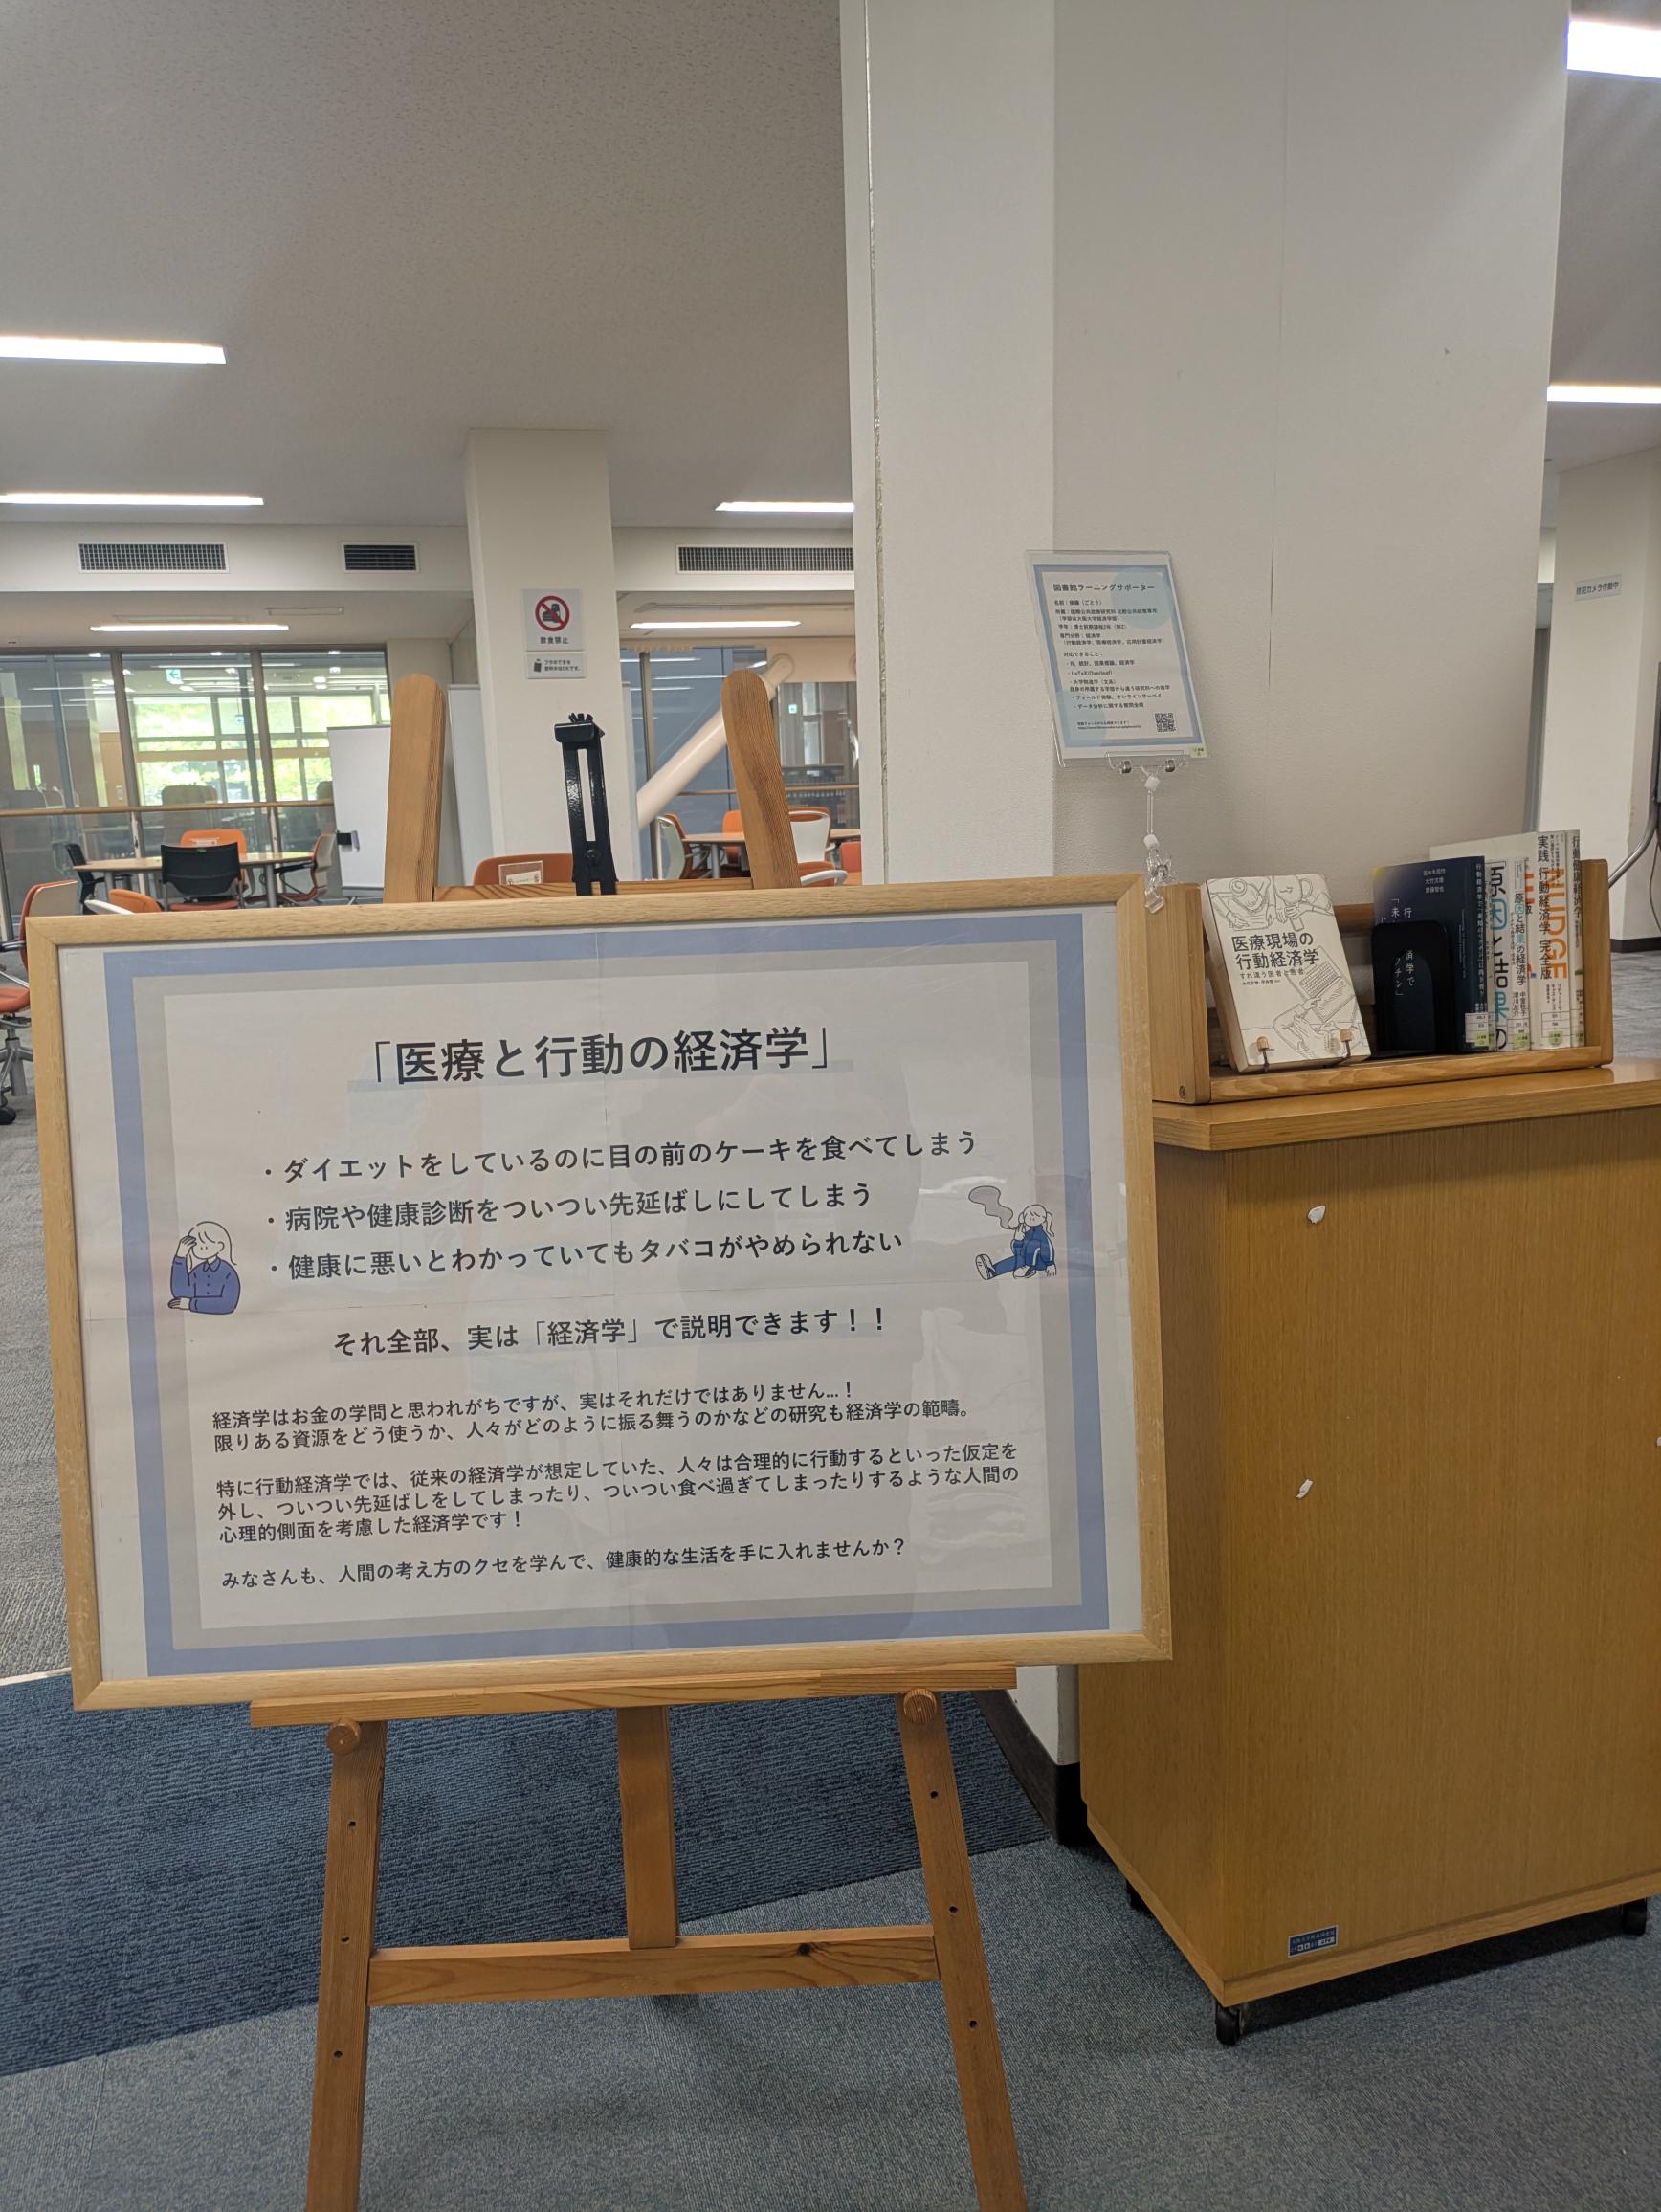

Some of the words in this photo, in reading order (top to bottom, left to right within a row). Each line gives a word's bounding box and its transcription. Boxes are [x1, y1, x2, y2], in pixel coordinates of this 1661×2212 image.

[1052, 583, 1156, 592] 図書館ラーニングサポーター
[540, 636, 569, 645] 飲食禁止
[1538, 835, 1550, 863] 実践
[1539, 867, 1551, 936] 行動経済学
[1231, 932, 1314, 953] 医療現場の
[1235, 948, 1319, 970] 行動経済学
[1539, 940, 1552, 980] 完全版
[375, 1027, 829, 1085] 「医療と行動の経済学」
[264, 1130, 976, 1183] ・ダイエットをしているのに目の前のケーキを食べてしまう
[267, 1182, 871, 1232] ・病院や健康診断をついつい先延ばしにしてしまう
[270, 1229, 902, 1281] ・健康に悪いとわかっていてもタバコがやめられない
[333, 1307, 884, 1357] それ全部、実は「経済学」で説明できます！！
[213, 1398, 969, 1454] 限りある資源をどう使うか、人々がどのように振る舞うのかなどの研究も経済学の範疇。
[216, 1441, 1017, 1499] 特に行動経済学では、従来の経済学が想定していた、人々は合理的に行動するといった仮定を
[217, 1464, 1020, 1521] 外し、ついつい先延ばしをしてしまったり、ついつい食べ過ぎてしまったりするような人間の
[218, 1510, 521, 1544] 心理的側面を考慮した経済学です！
[221, 1537, 905, 1589] みなさんも、人間の考え方のクセを学んで、健康的な生活を手に入れませんか？
